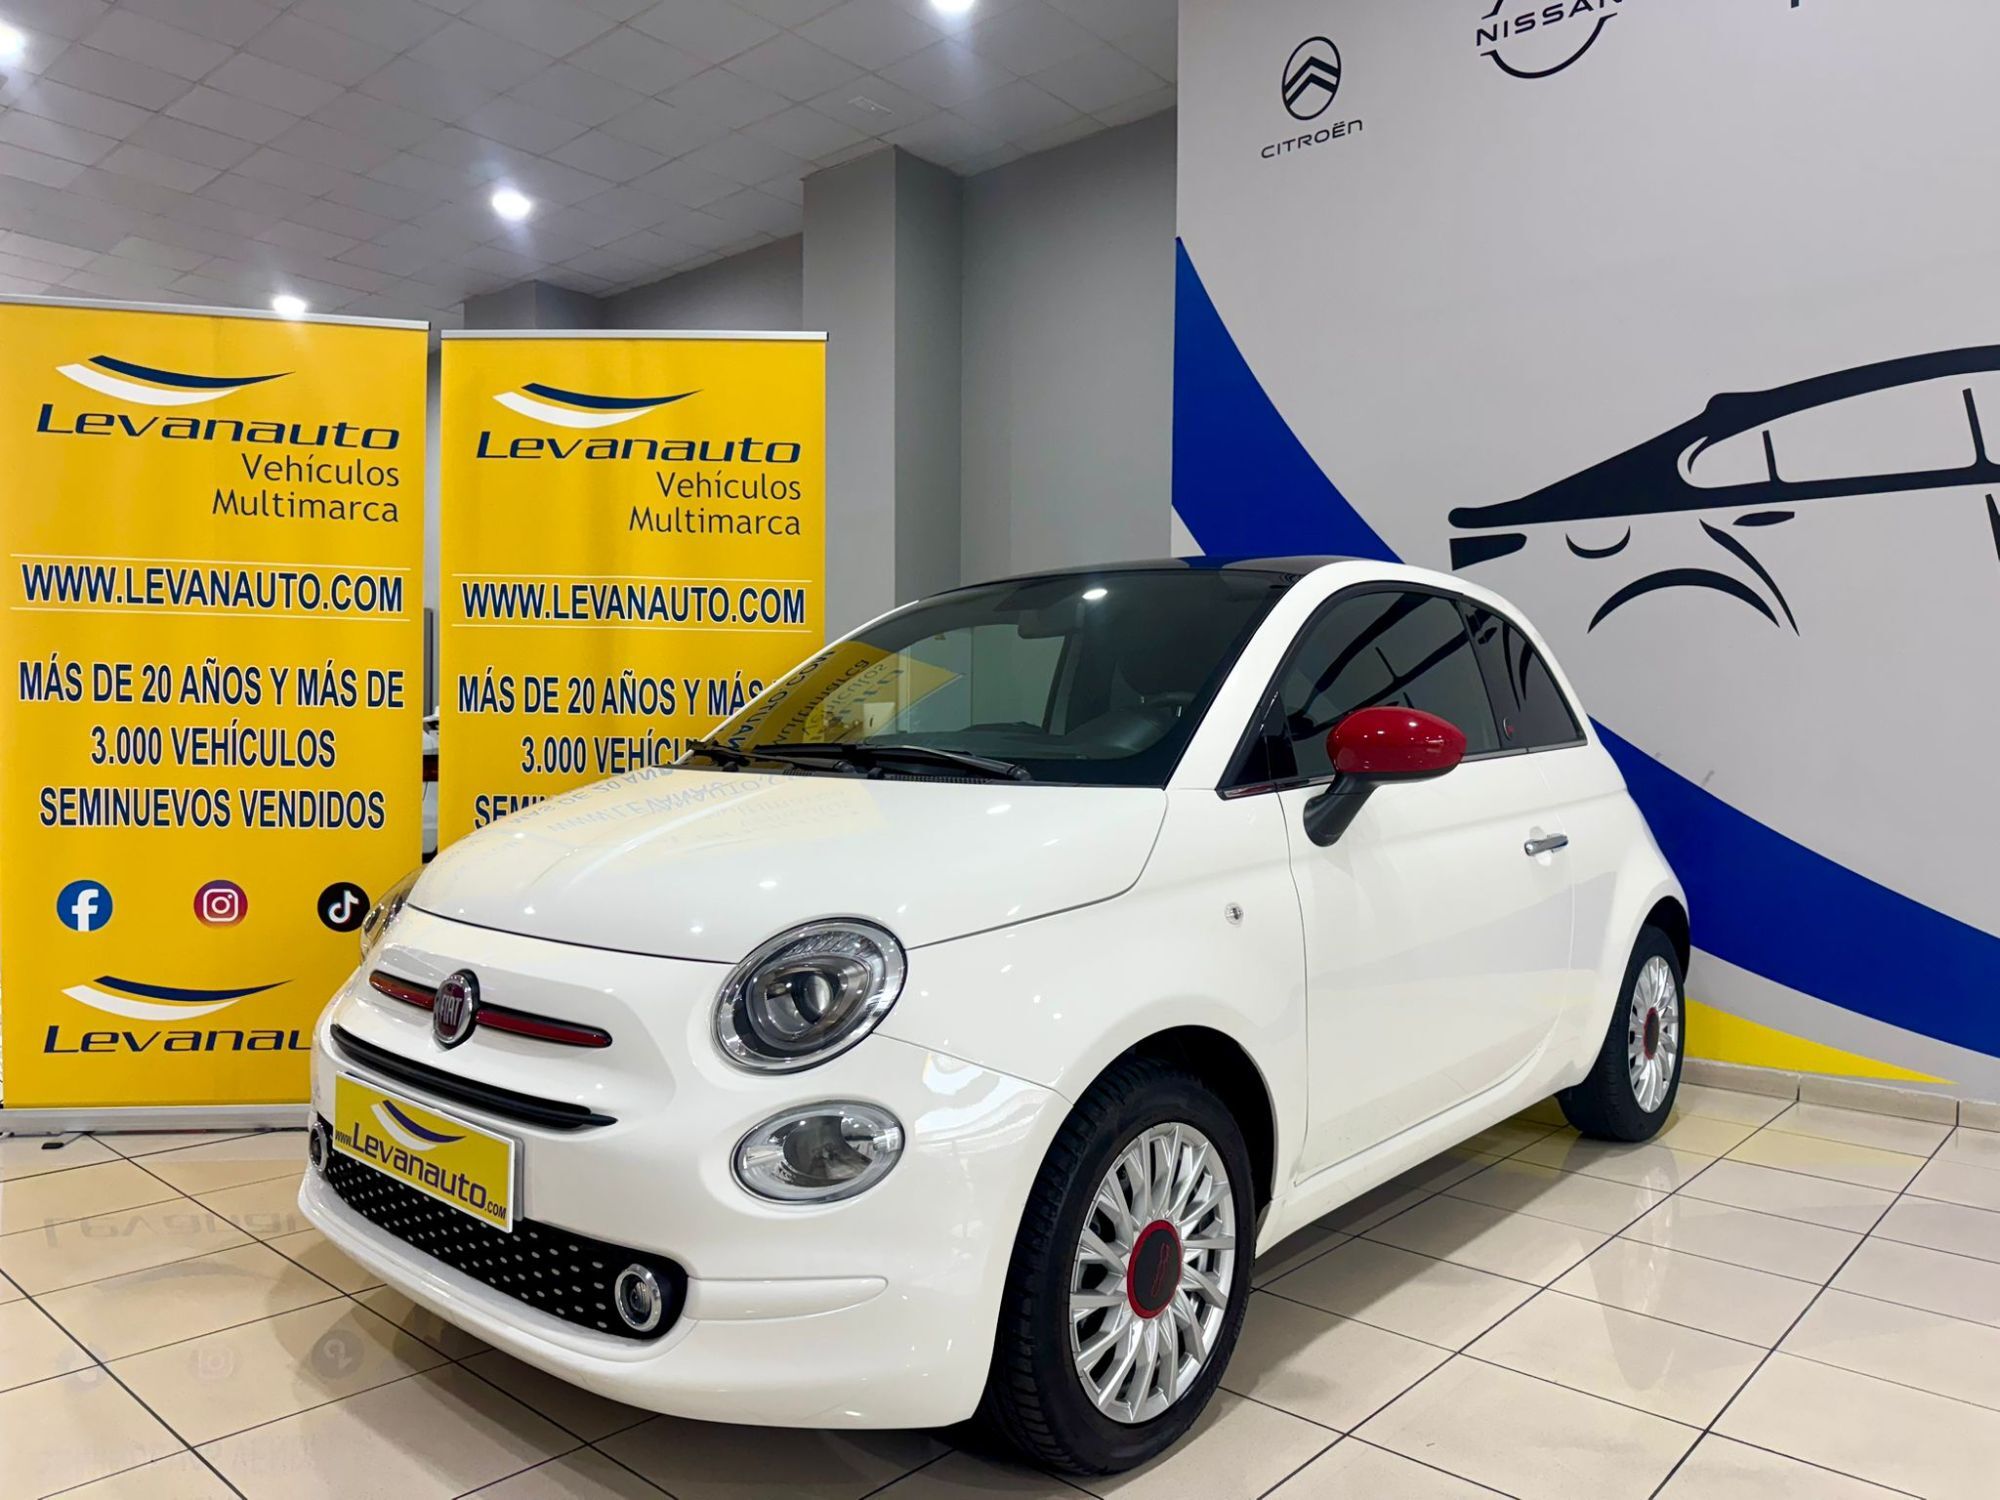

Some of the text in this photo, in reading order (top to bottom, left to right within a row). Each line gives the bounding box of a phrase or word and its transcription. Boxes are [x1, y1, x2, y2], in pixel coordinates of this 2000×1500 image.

[37, 404, 400, 449] Levanauto
[477, 431, 801, 463] Levanauto
[242, 454, 399, 486] Vehículos
[657, 470, 801, 500] Vehículos
[212, 489, 399, 522] Multimarca
[629, 507, 801, 535] Multimarca
[22, 564, 402, 612] WWW.LEVANAUTO.COM
[462, 583, 804, 624] WWW.LEVANAUTO.COM
[20, 653, 404, 708] MÁS DE 20 AÑOS Y MÁS DE
[459, 667, 515, 713] MÁS
[525, 677, 559, 713] DE
[567, 678, 595, 714] 20
[602, 670, 676, 715] AÑOS
[683, 679, 701, 715] Y
[91, 719, 335, 767] 3.000 VEHÍCULOS
[521, 729, 697, 774] 3.000 VEHÍC
[40, 787, 385, 829] SEMINUEVOS VENDIDOS
[439, 994, 464, 1027] FIAT
